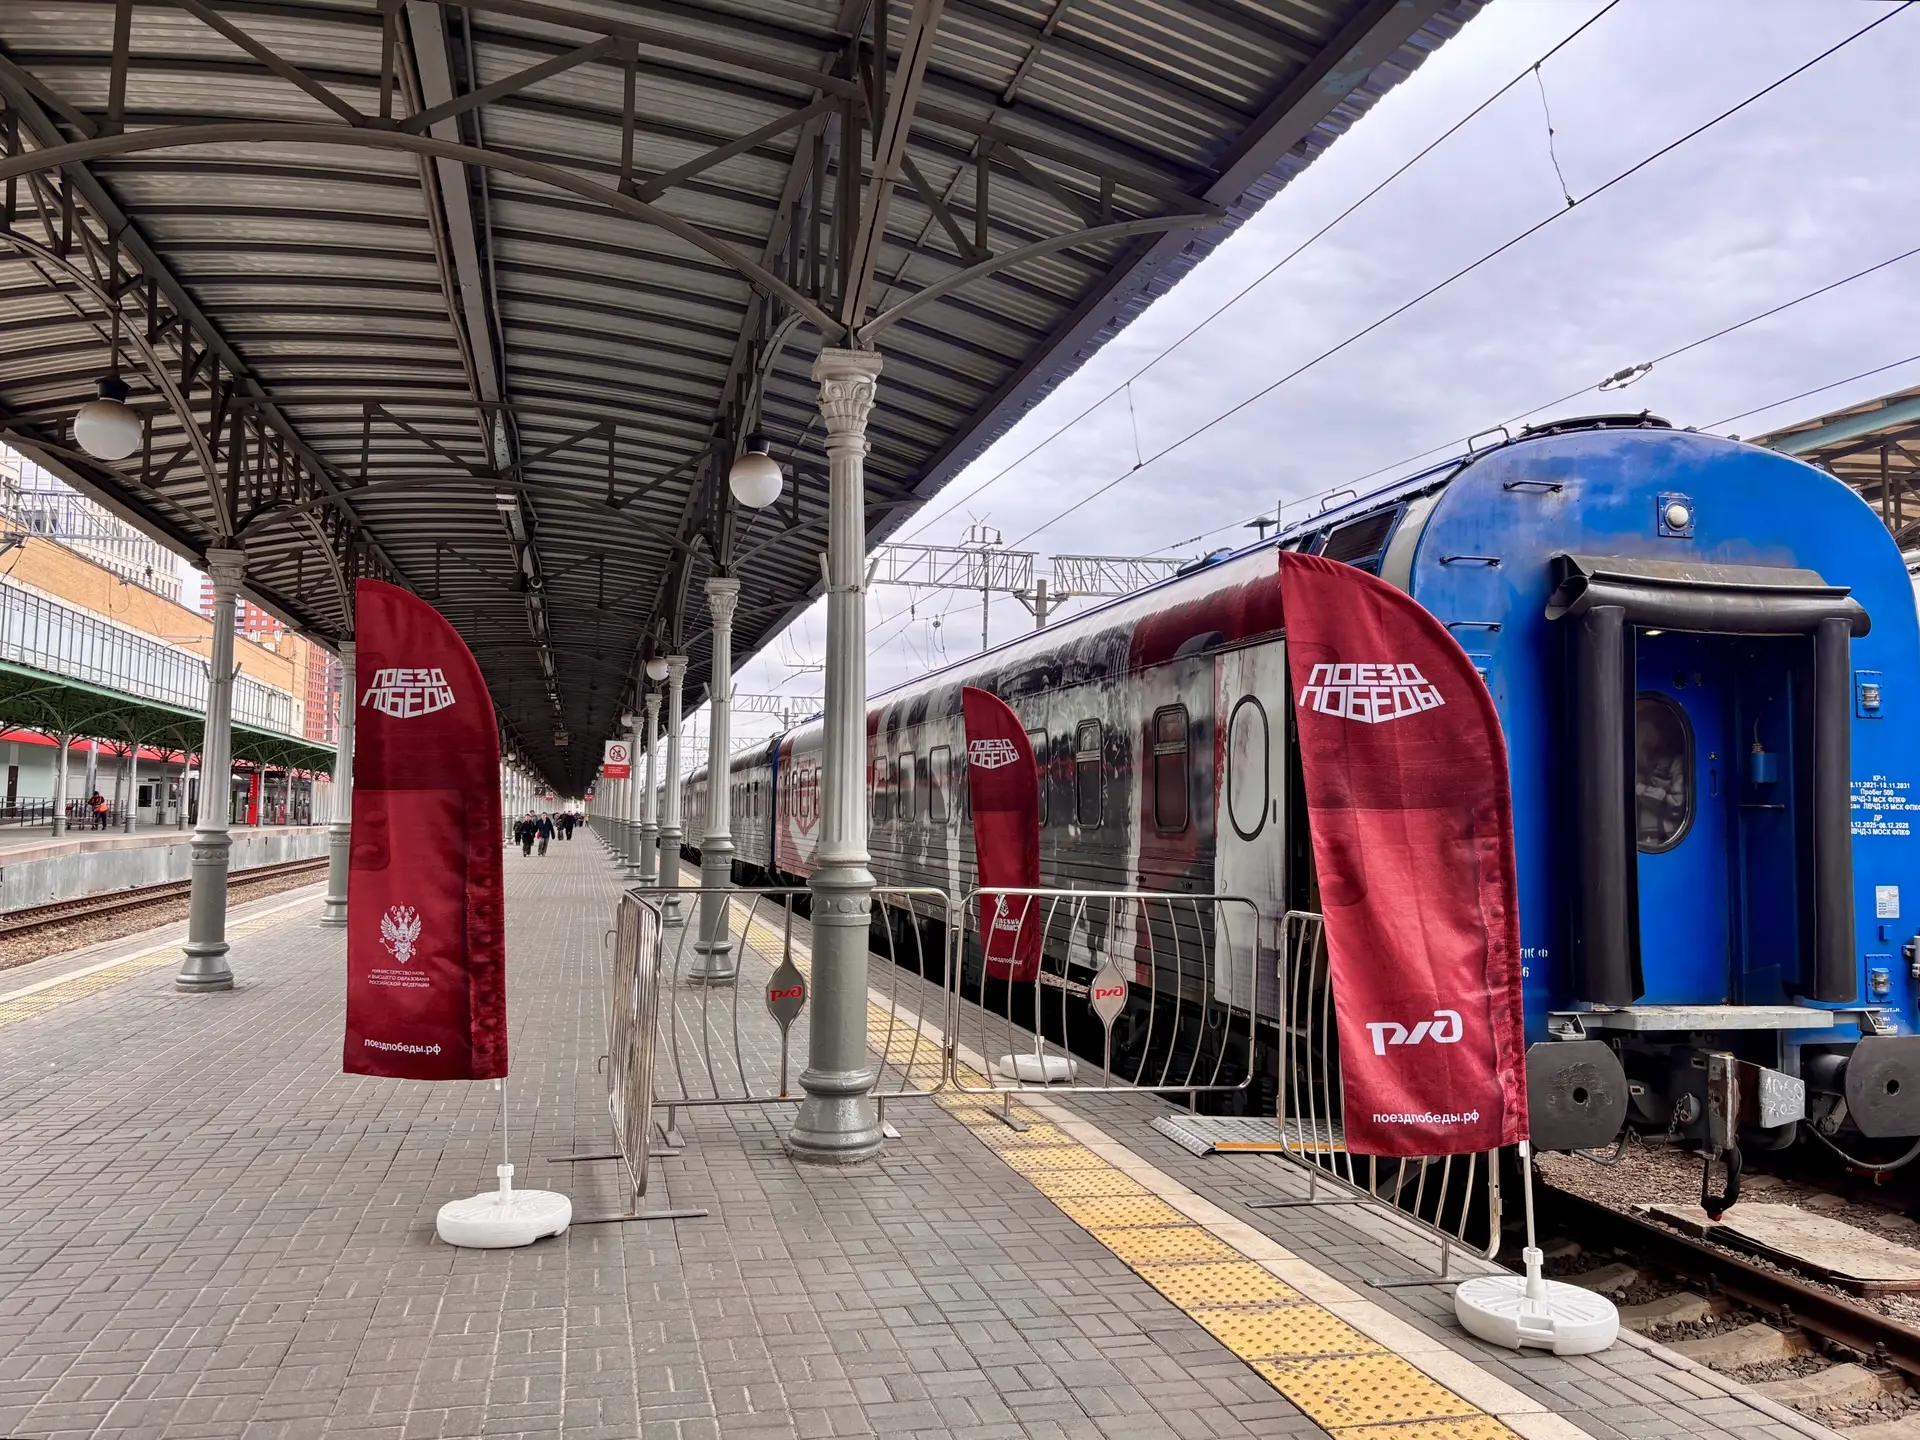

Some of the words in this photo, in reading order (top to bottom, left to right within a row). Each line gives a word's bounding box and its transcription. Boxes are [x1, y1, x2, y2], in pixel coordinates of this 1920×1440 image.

[371, 668, 449, 688] ПОЕЗД
[1308, 663, 1430, 686] ПОЕЗД
[361, 686, 457, 719] ПОБЕДЫ
[1298, 684, 1447, 724] ПОБЕДЫ
[969, 738, 1015, 751] ПОЕЗД
[968, 749, 1020, 770] ПОБЕДЫ
[364, 1038, 442, 1056] поездпобеды.рф
[1372, 1109, 1481, 1125] поездпобеды.рф
